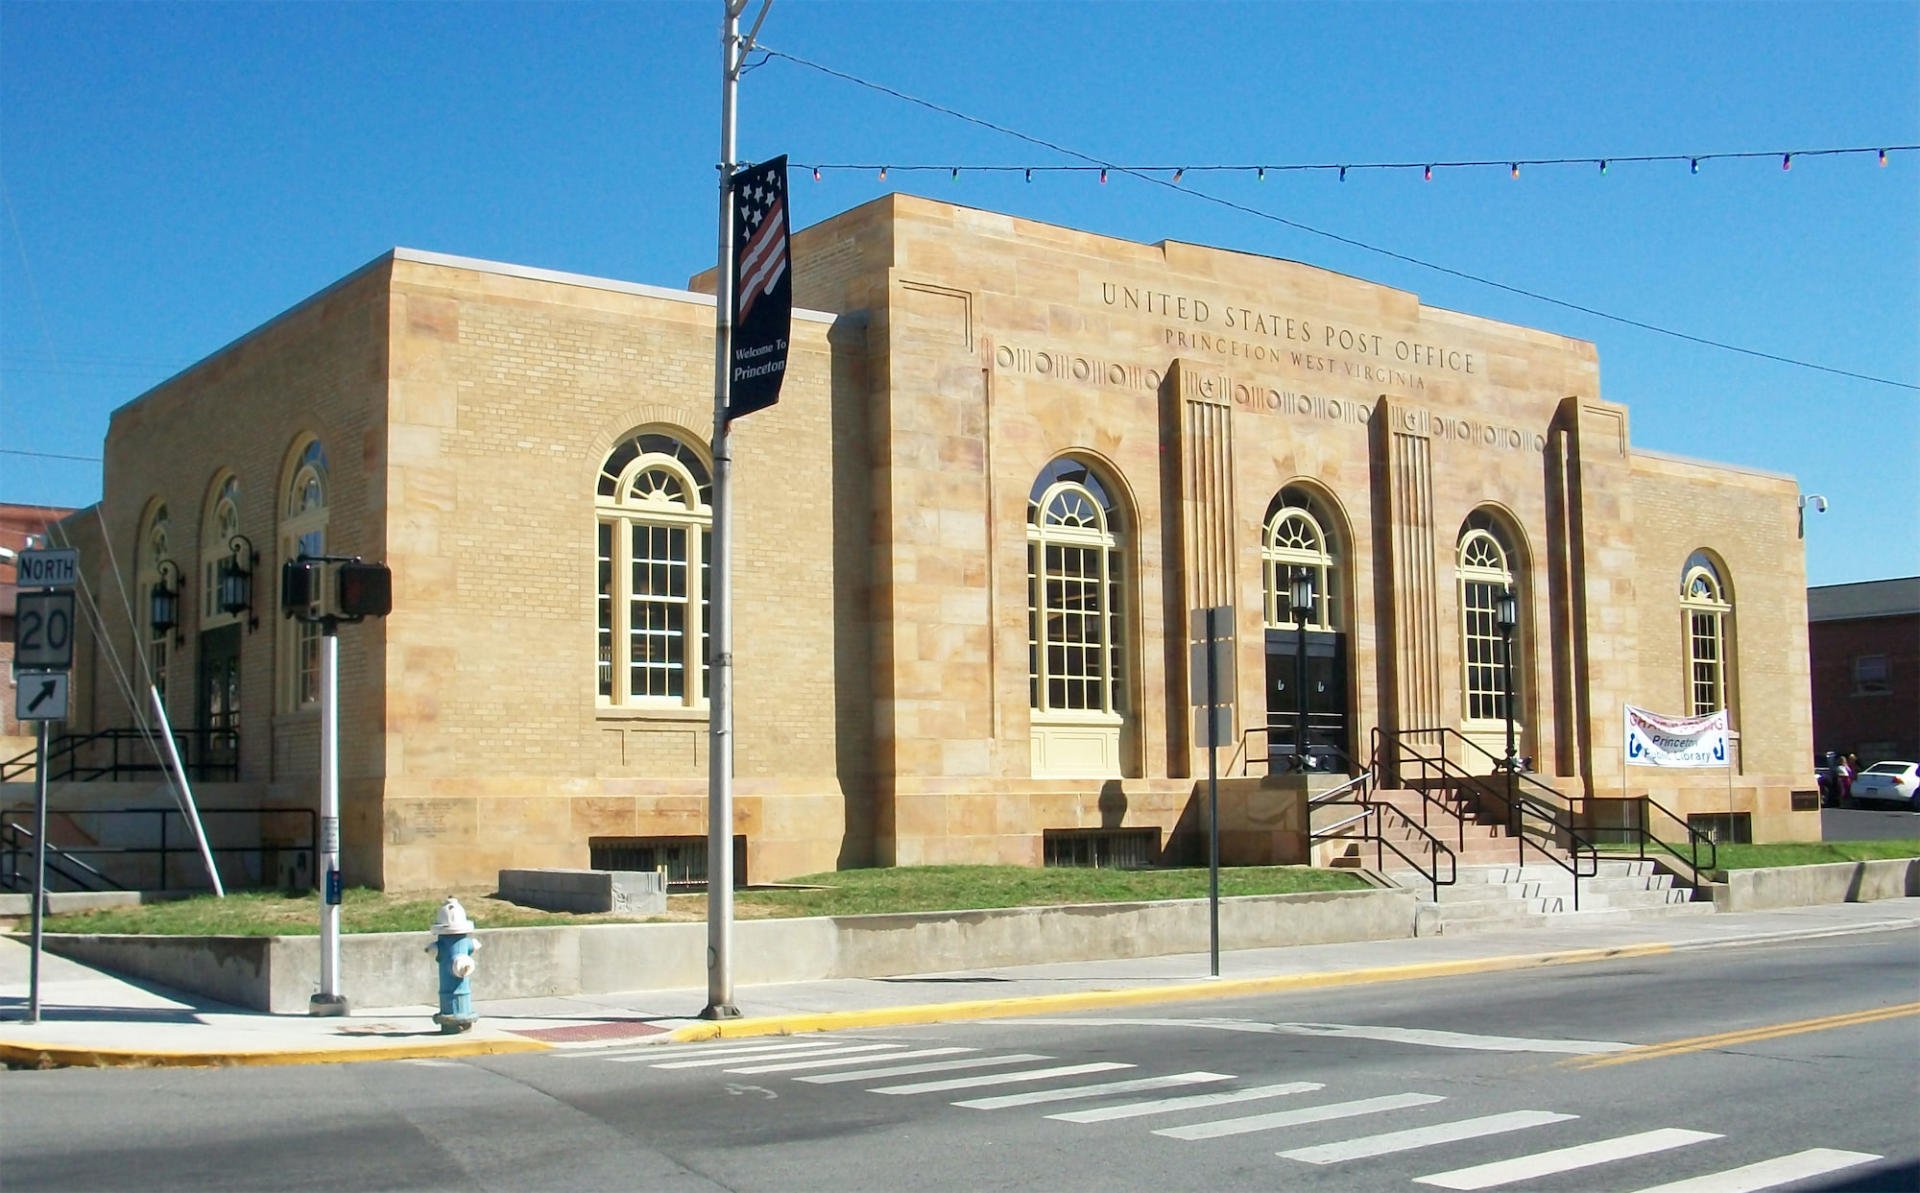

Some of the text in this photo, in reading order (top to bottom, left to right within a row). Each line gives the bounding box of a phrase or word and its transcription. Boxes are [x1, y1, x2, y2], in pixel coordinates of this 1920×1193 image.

[1102, 282, 1475, 374] UNITED STATES POST OFFICE
[736, 338, 787, 360] Welcome To
[1165, 328, 1425, 390] PRINCETON WEST VIRGINIA
[734, 360, 785, 382] Princeton
[20, 557, 74, 580] NORTH
[20, 609, 69, 650] 20
